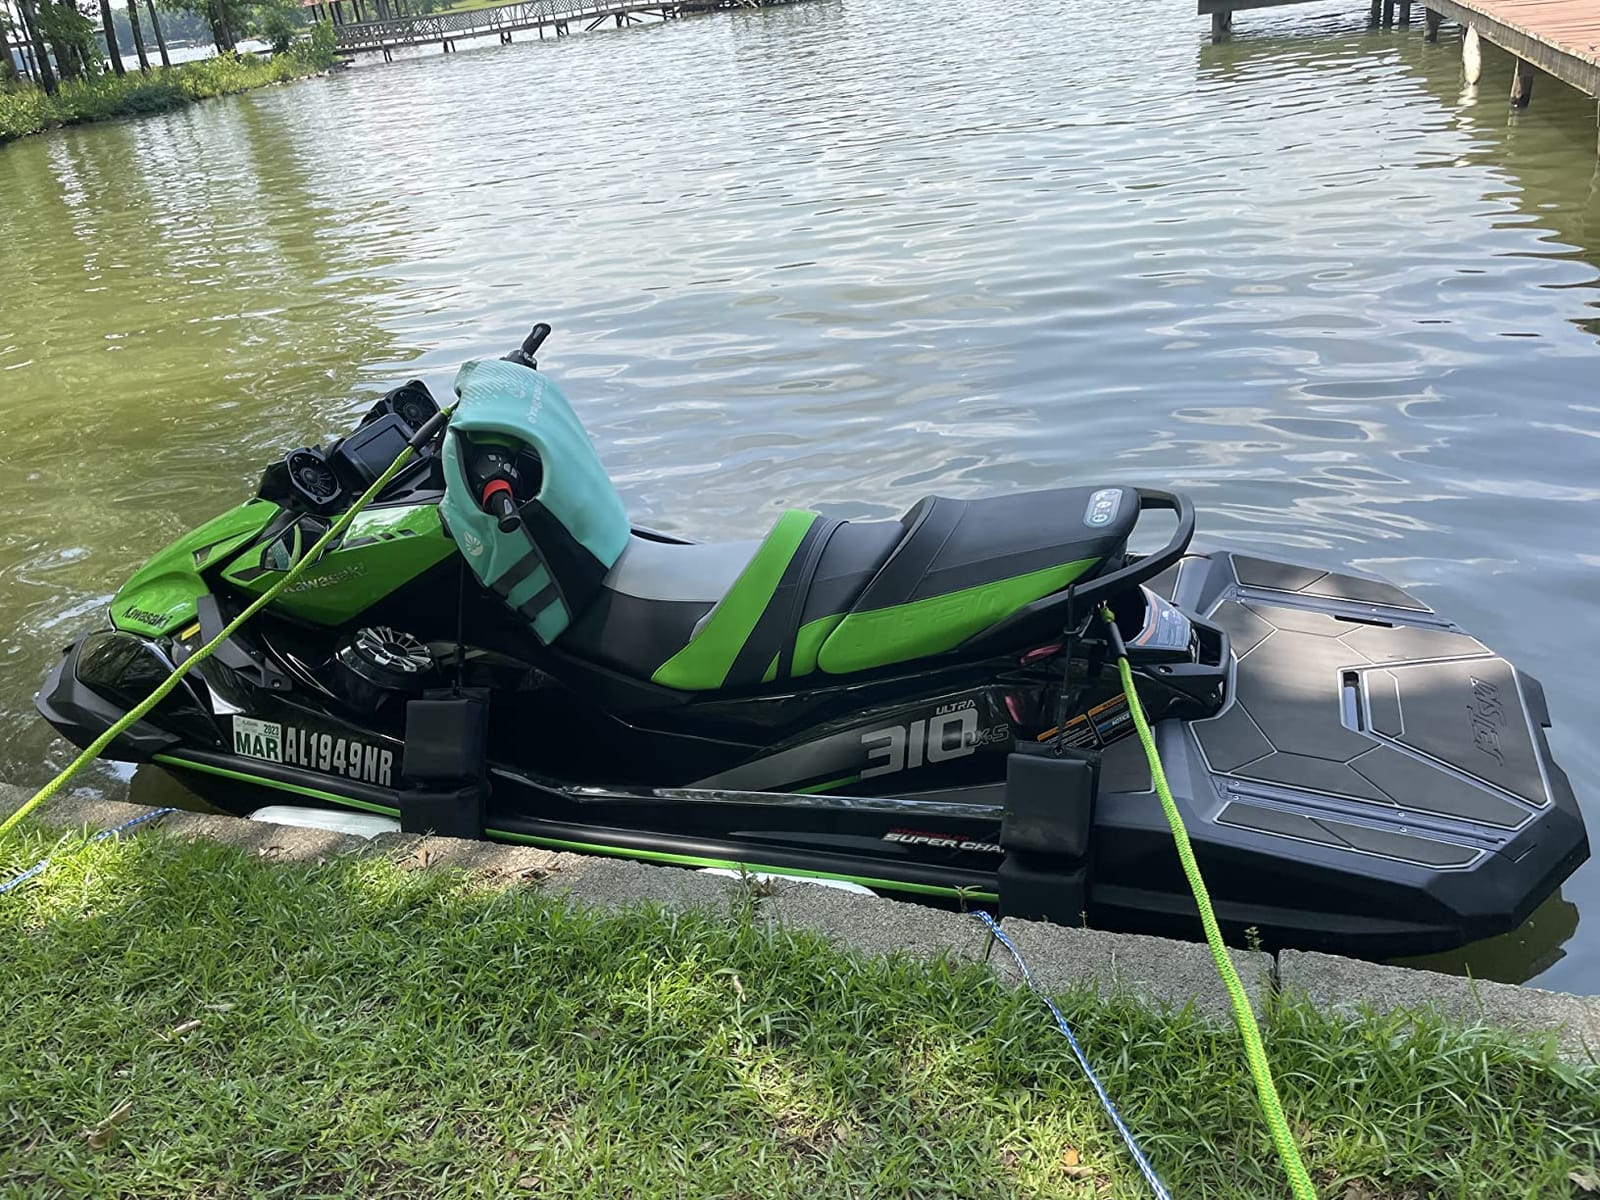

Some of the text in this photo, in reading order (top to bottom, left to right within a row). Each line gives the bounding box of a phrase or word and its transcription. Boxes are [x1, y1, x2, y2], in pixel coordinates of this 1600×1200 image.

[121, 605, 174, 629] Kawasaki
[935, 699, 976, 716] ULTRA
[263, 723, 280, 736] 2023
[235, 731, 281, 762] MAR
[860, 708, 979, 780] 310
[285, 726, 393, 787] AL1949NR
[882, 832, 957, 848] SUPER
[959, 841, 1005, 853] CHA
